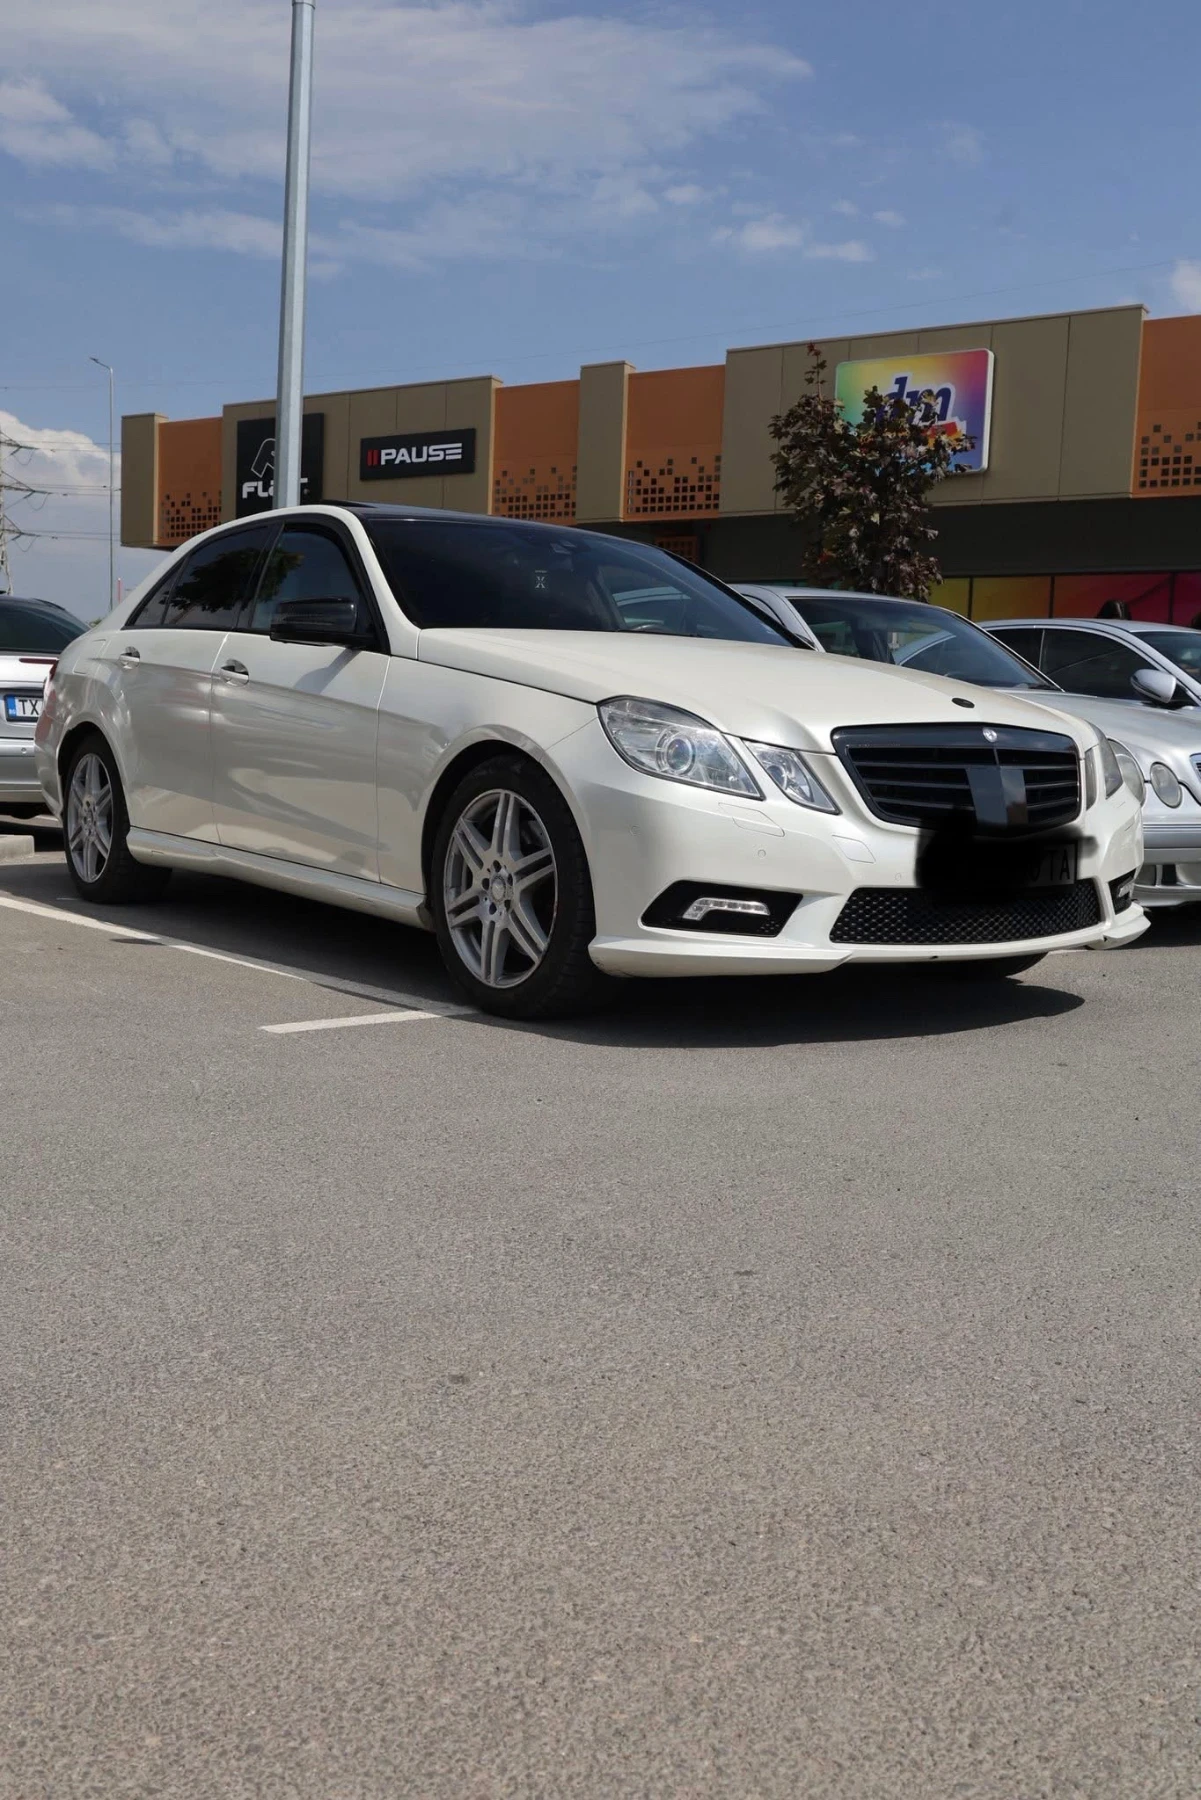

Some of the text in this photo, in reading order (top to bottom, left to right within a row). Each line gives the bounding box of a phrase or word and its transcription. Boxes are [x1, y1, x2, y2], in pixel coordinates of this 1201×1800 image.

[876, 376, 952, 424] dm
[380, 442, 463, 466] PAUSE
[18, 699, 40, 715] TX
